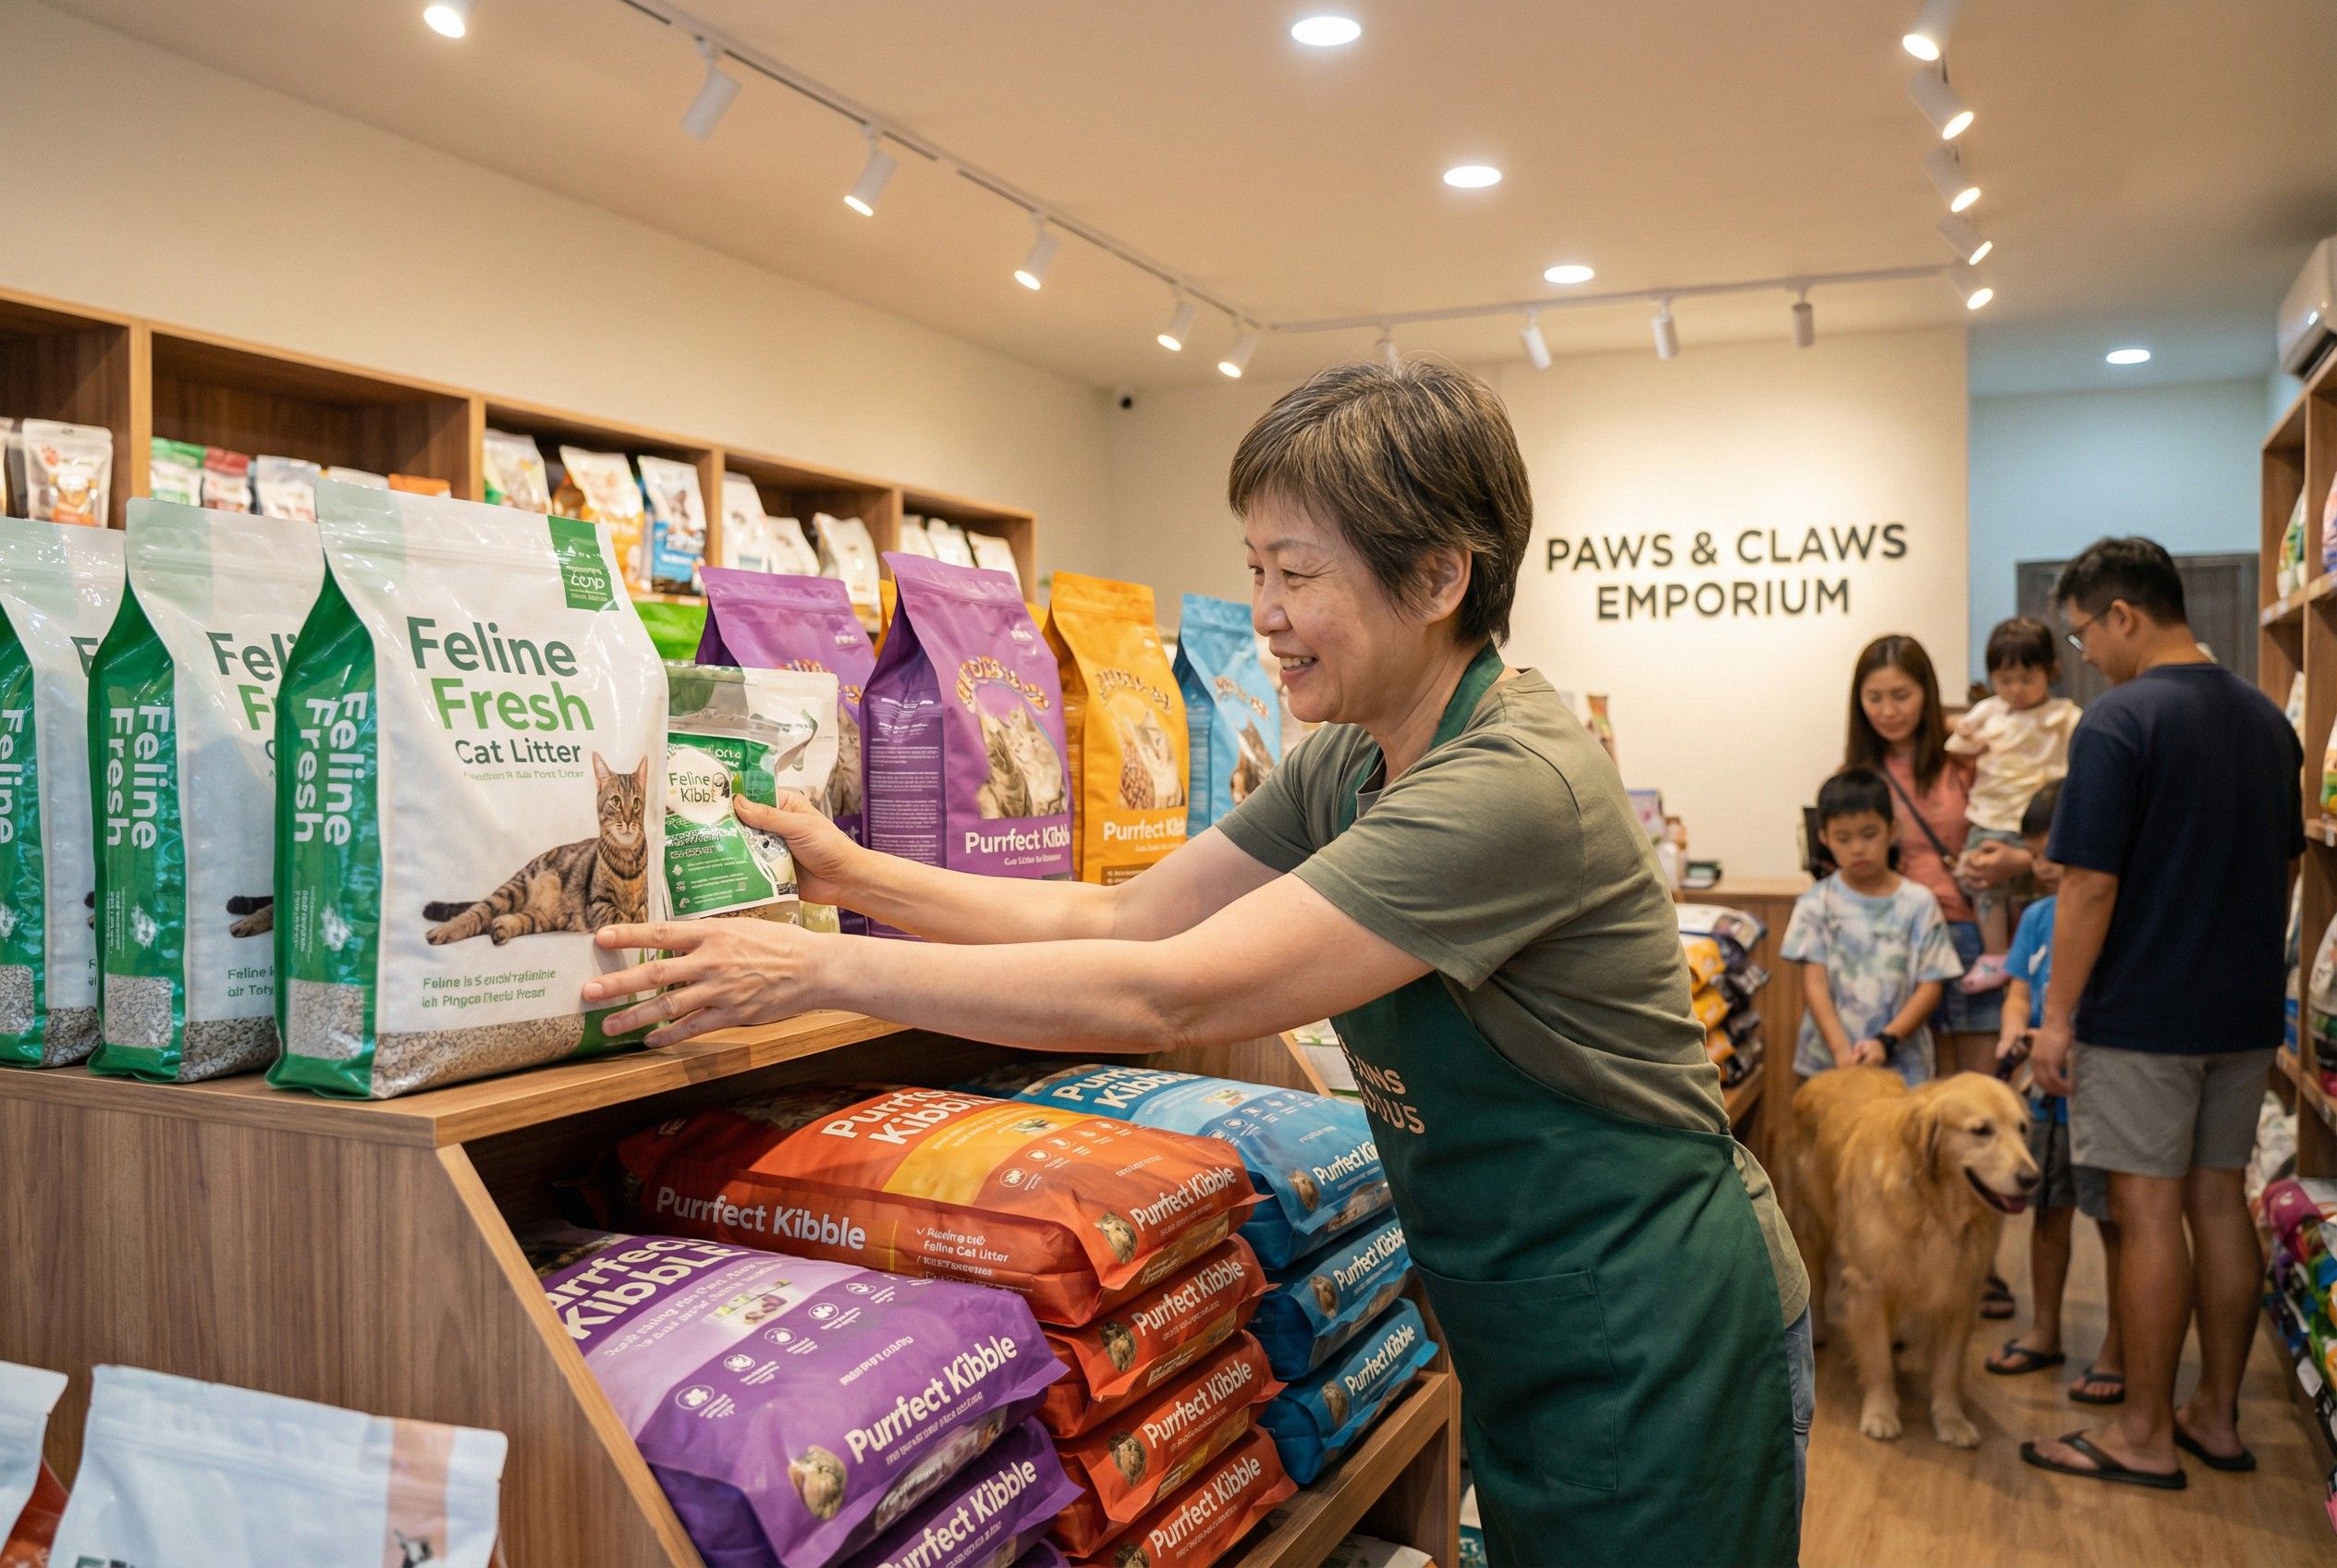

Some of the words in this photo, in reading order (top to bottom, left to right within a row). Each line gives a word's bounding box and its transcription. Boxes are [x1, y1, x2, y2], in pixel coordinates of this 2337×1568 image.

[1547, 533, 1674, 571] PAWS
[1691, 532, 1718, 566] &
[1737, 523, 1908, 564] CLAWS
[1597, 579, 1849, 620] EMPORIUM
[205, 631, 298, 682] Fel
[407, 616, 579, 677] Feline
[431, 677, 595, 731] Fresh
[107, 708, 135, 846] Fresh
[131, 705, 170, 849] Feline
[294, 698, 341, 842] Fresh
[324, 692, 368, 846] Feline
[455, 739, 505, 765] Cat
[509, 737, 581, 763] Litter
[668, 771, 710, 786] Feline
[965, 828, 1040, 854] Purrfect
[1103, 819, 1164, 841] Purrfect
[656, 1186, 767, 1232] Purrfect
[773, 1206, 866, 1250] Kibble
[1130, 1184, 1194, 1232] Purrfect
[1187, 1166, 1237, 1200] Kibble
[1131, 1283, 1201, 1337] Purrfect
[1193, 1259, 1244, 1299] Kibble
[843, 1378, 951, 1464] Purrfect
[942, 1335, 1018, 1395] Kibble
[1142, 1388, 1212, 1450] Purrfect
[1205, 1359, 1253, 1404] Kibble
[875, 1506, 975, 1568] rrfect
[969, 1460, 1037, 1524] Kibble
[1148, 1489, 1217, 1559] Purrfect
[1211, 1456, 1261, 1505] Kibble
